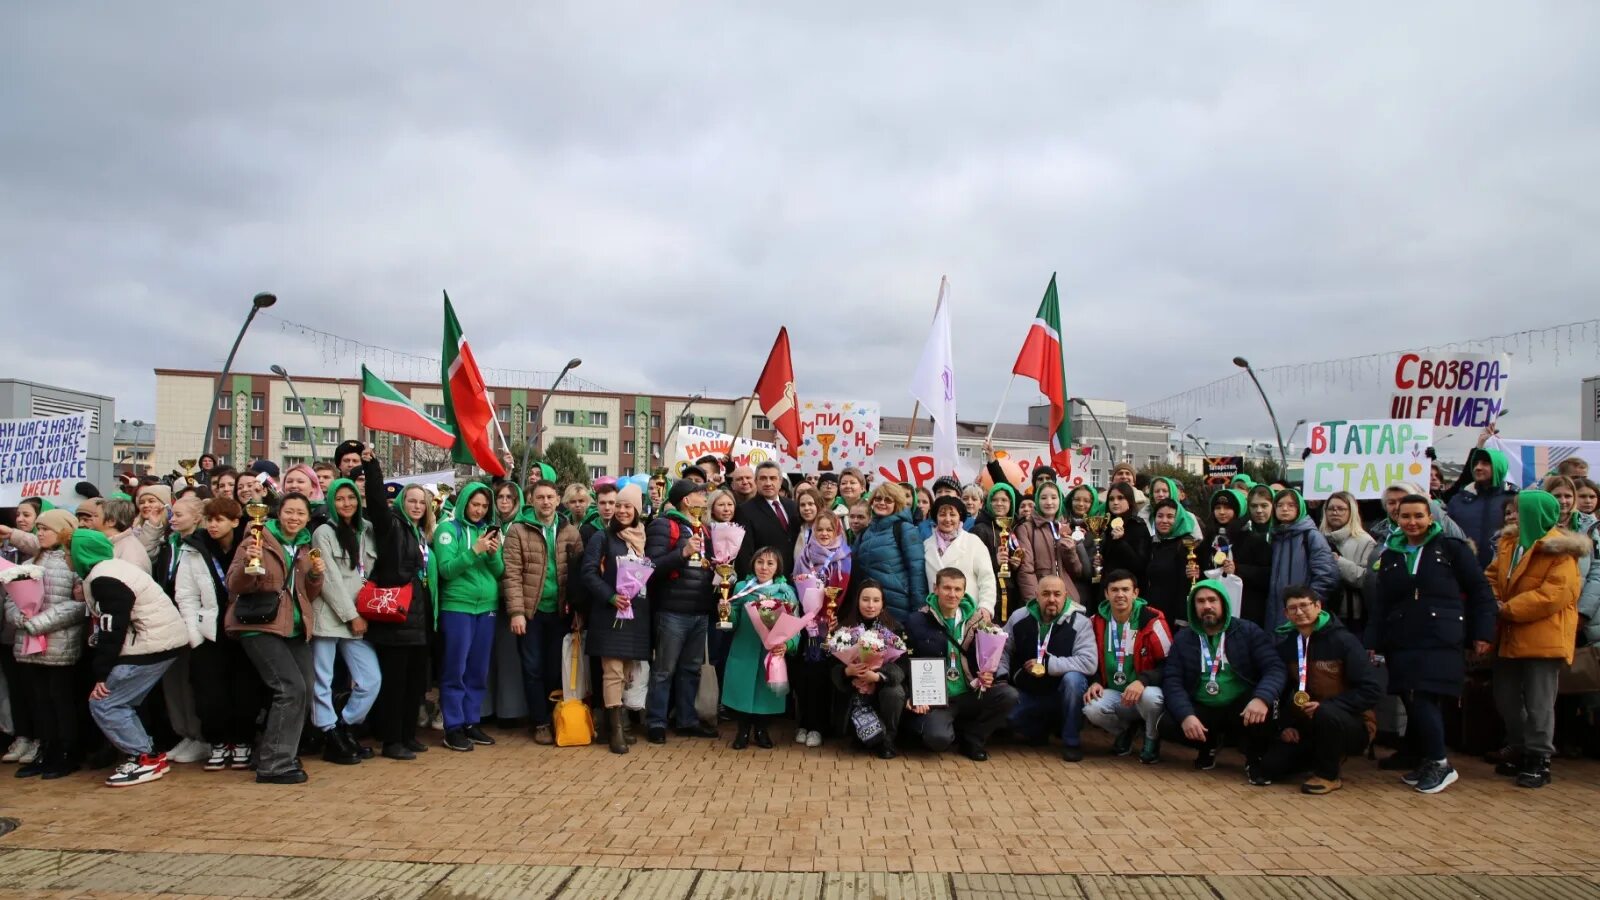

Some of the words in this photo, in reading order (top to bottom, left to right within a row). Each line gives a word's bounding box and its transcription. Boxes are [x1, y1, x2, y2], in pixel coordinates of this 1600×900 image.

[18, 420, 48, 437] ШАГУ
[687, 426, 721, 439] ГАПОУ
[780, 413, 880, 456] ЧМПИОНЫ
[15, 435, 46, 452] ШАГУ
[47, 434, 61, 449] НА
[10, 453, 17, 468] А
[0, 468, 14, 484] ЕД
[21, 480, 62, 497] ВМЕСТЕ
